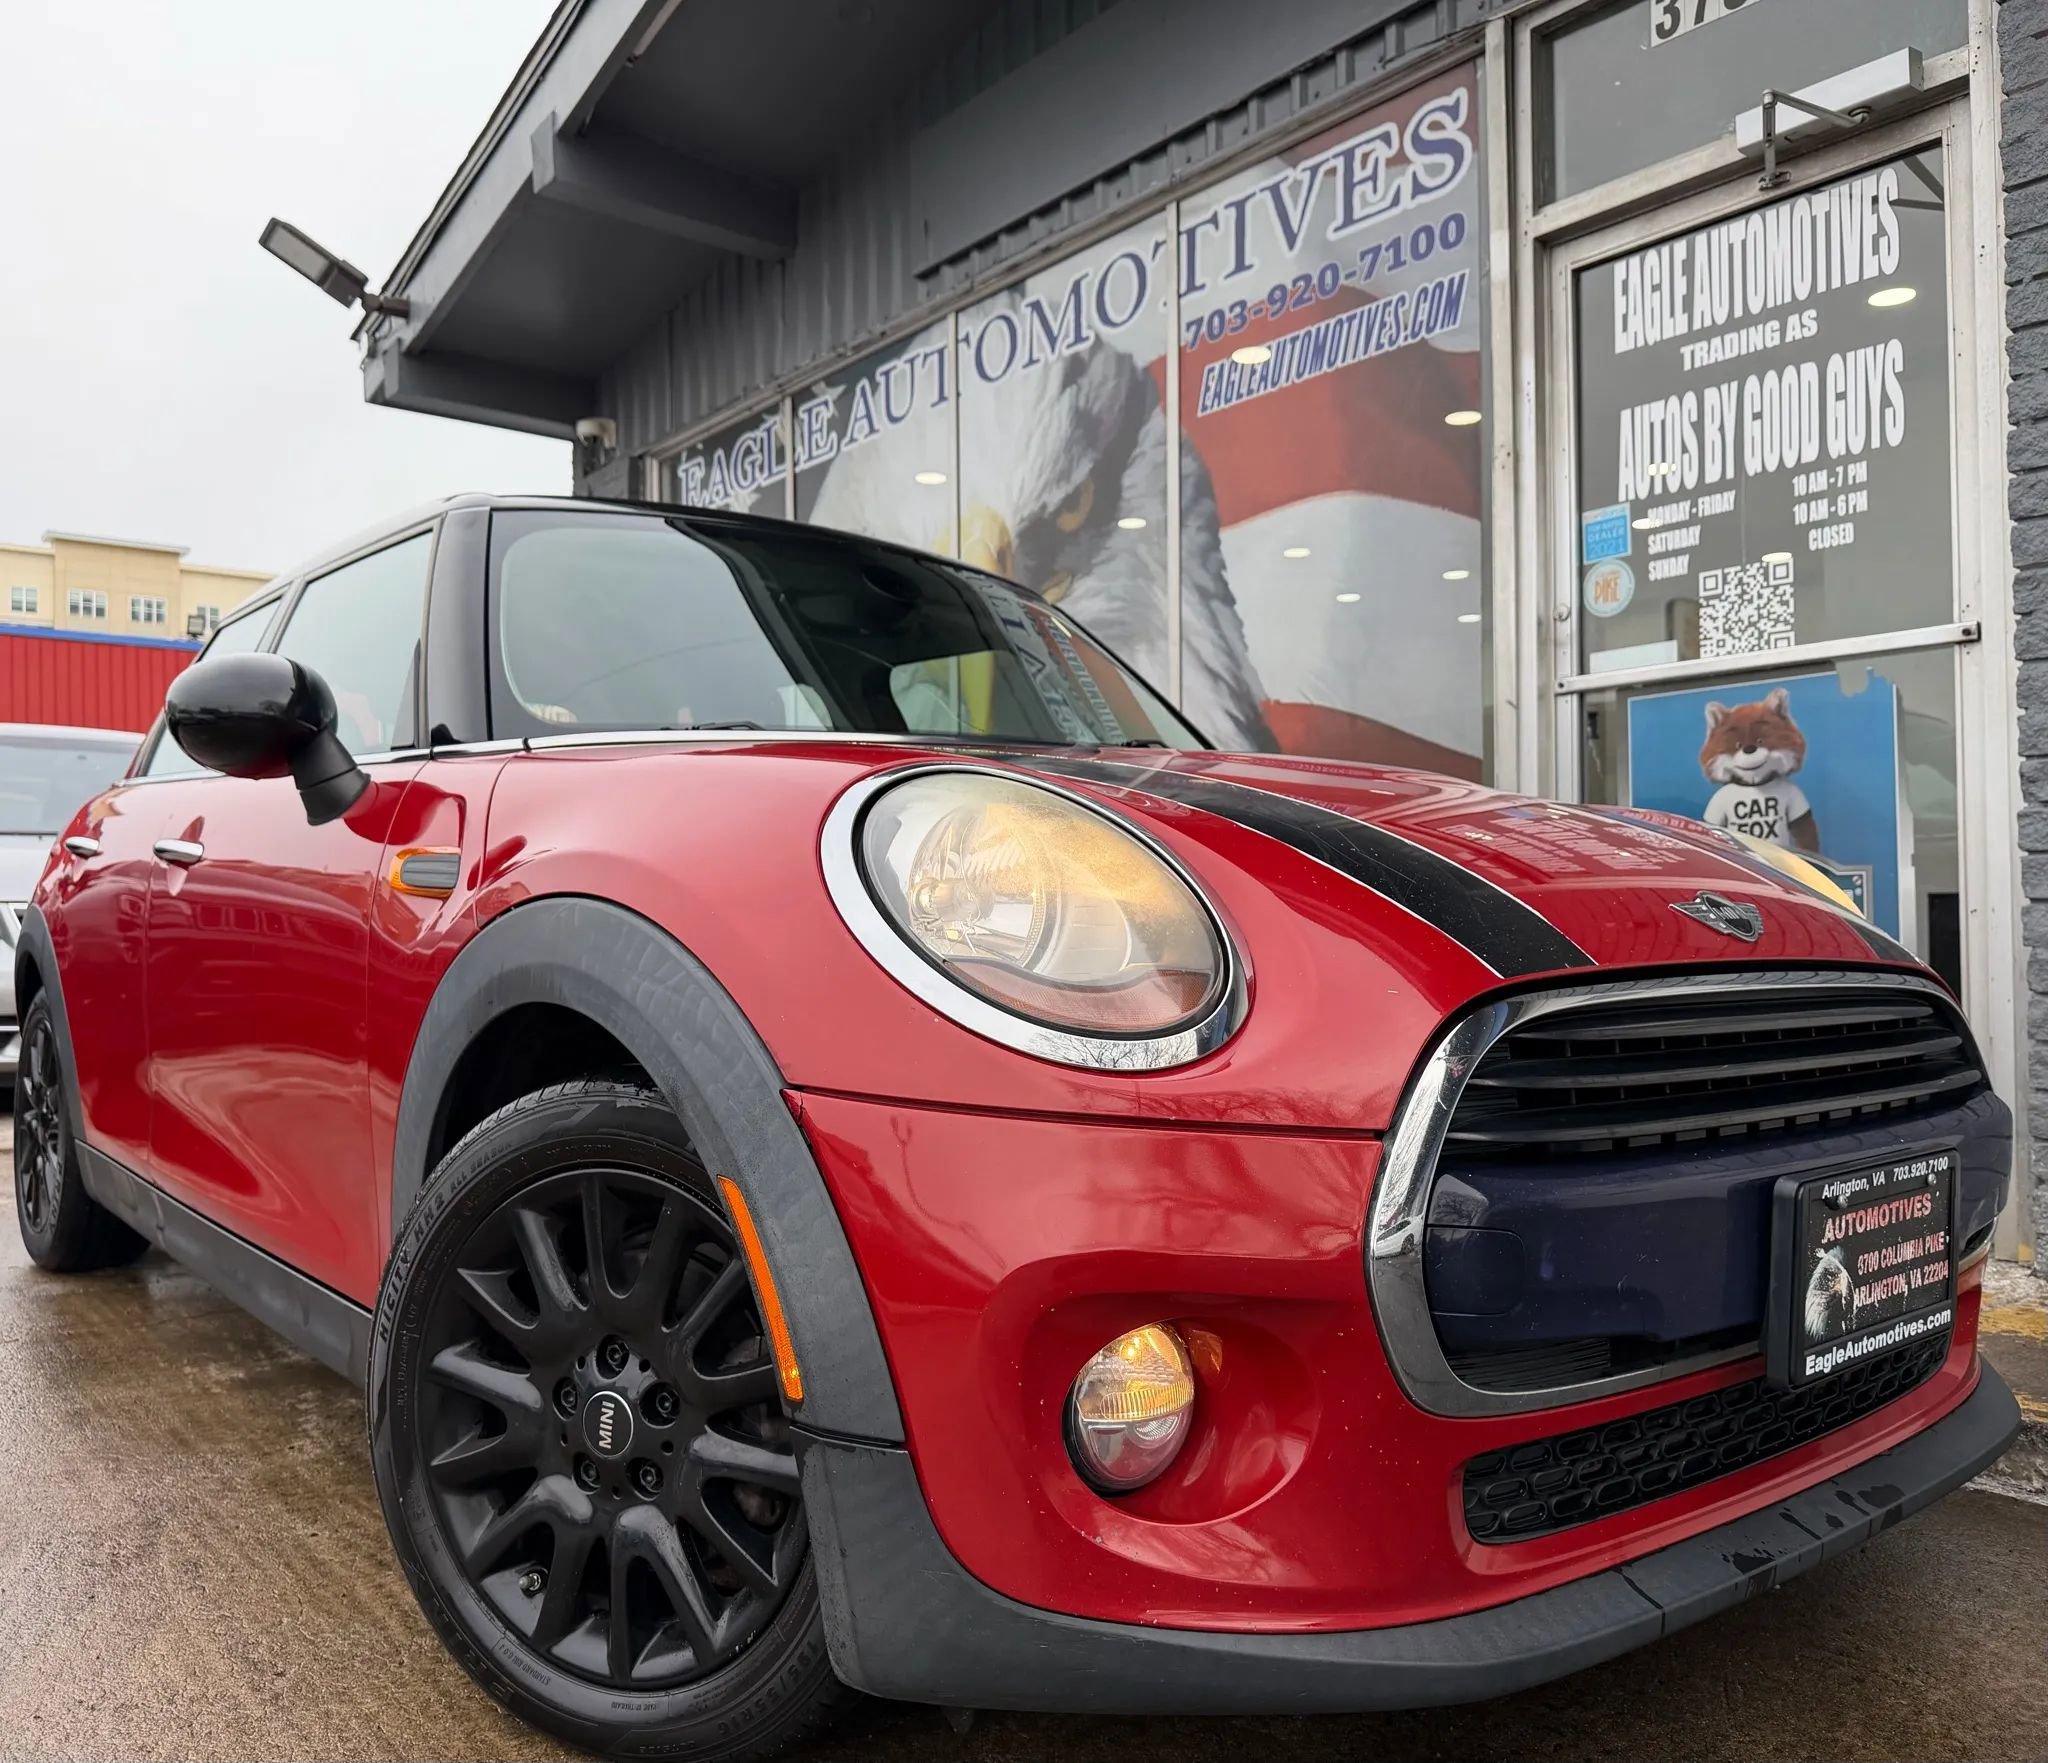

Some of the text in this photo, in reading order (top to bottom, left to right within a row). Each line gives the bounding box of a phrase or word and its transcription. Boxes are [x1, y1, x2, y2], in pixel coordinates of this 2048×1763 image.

[1184, 211, 1467, 352] 703-920-7100
[1613, 168, 1900, 355] EAGLE AUTOMOTIVES
[678, 88, 1473, 508] EAGLE AUTOMOTIVES
[1198, 269, 1471, 416] EAGLEAUTOMOTIVES.COM
[1680, 308, 1819, 372] TRADING AS
[1618, 338, 1905, 503] AUTOS BY GOOD GUYS
[1792, 474, 1808, 497] 10
[1808, 469, 1828, 495] AM
[1835, 466, 1844, 488] 7
[1848, 460, 1868, 485] PM
[1648, 500, 1691, 527] MONDAY
[1698, 490, 1736, 518] FRIDAY
[1792, 503, 1808, 526] 10
[1809, 498, 1829, 522] AM
[1837, 495, 1846, 517] 6
[1848, 490, 1868, 514] PM
[1648, 525, 1701, 555] SATURDAY
[1808, 522, 1854, 551] CLOSED
[1648, 554, 1690, 582] SUNDAY
[1734, 796, 1779, 820] CAR
[1822, 1156, 1949, 1200] Arlington, VA 703.920.7100
[1822, 1193, 1932, 1244] AUTOMOTIVES
[1880, 1237, 1924, 1269] COLUMBIA
[1925, 1231, 1945, 1254] PIKE
[1910, 1268, 1922, 1289] VA
[1923, 1259, 1949, 1286] 22204
[1805, 1309, 1952, 1376] EagleAutomotives.com
[598, 1401, 615, 1449] MINI
